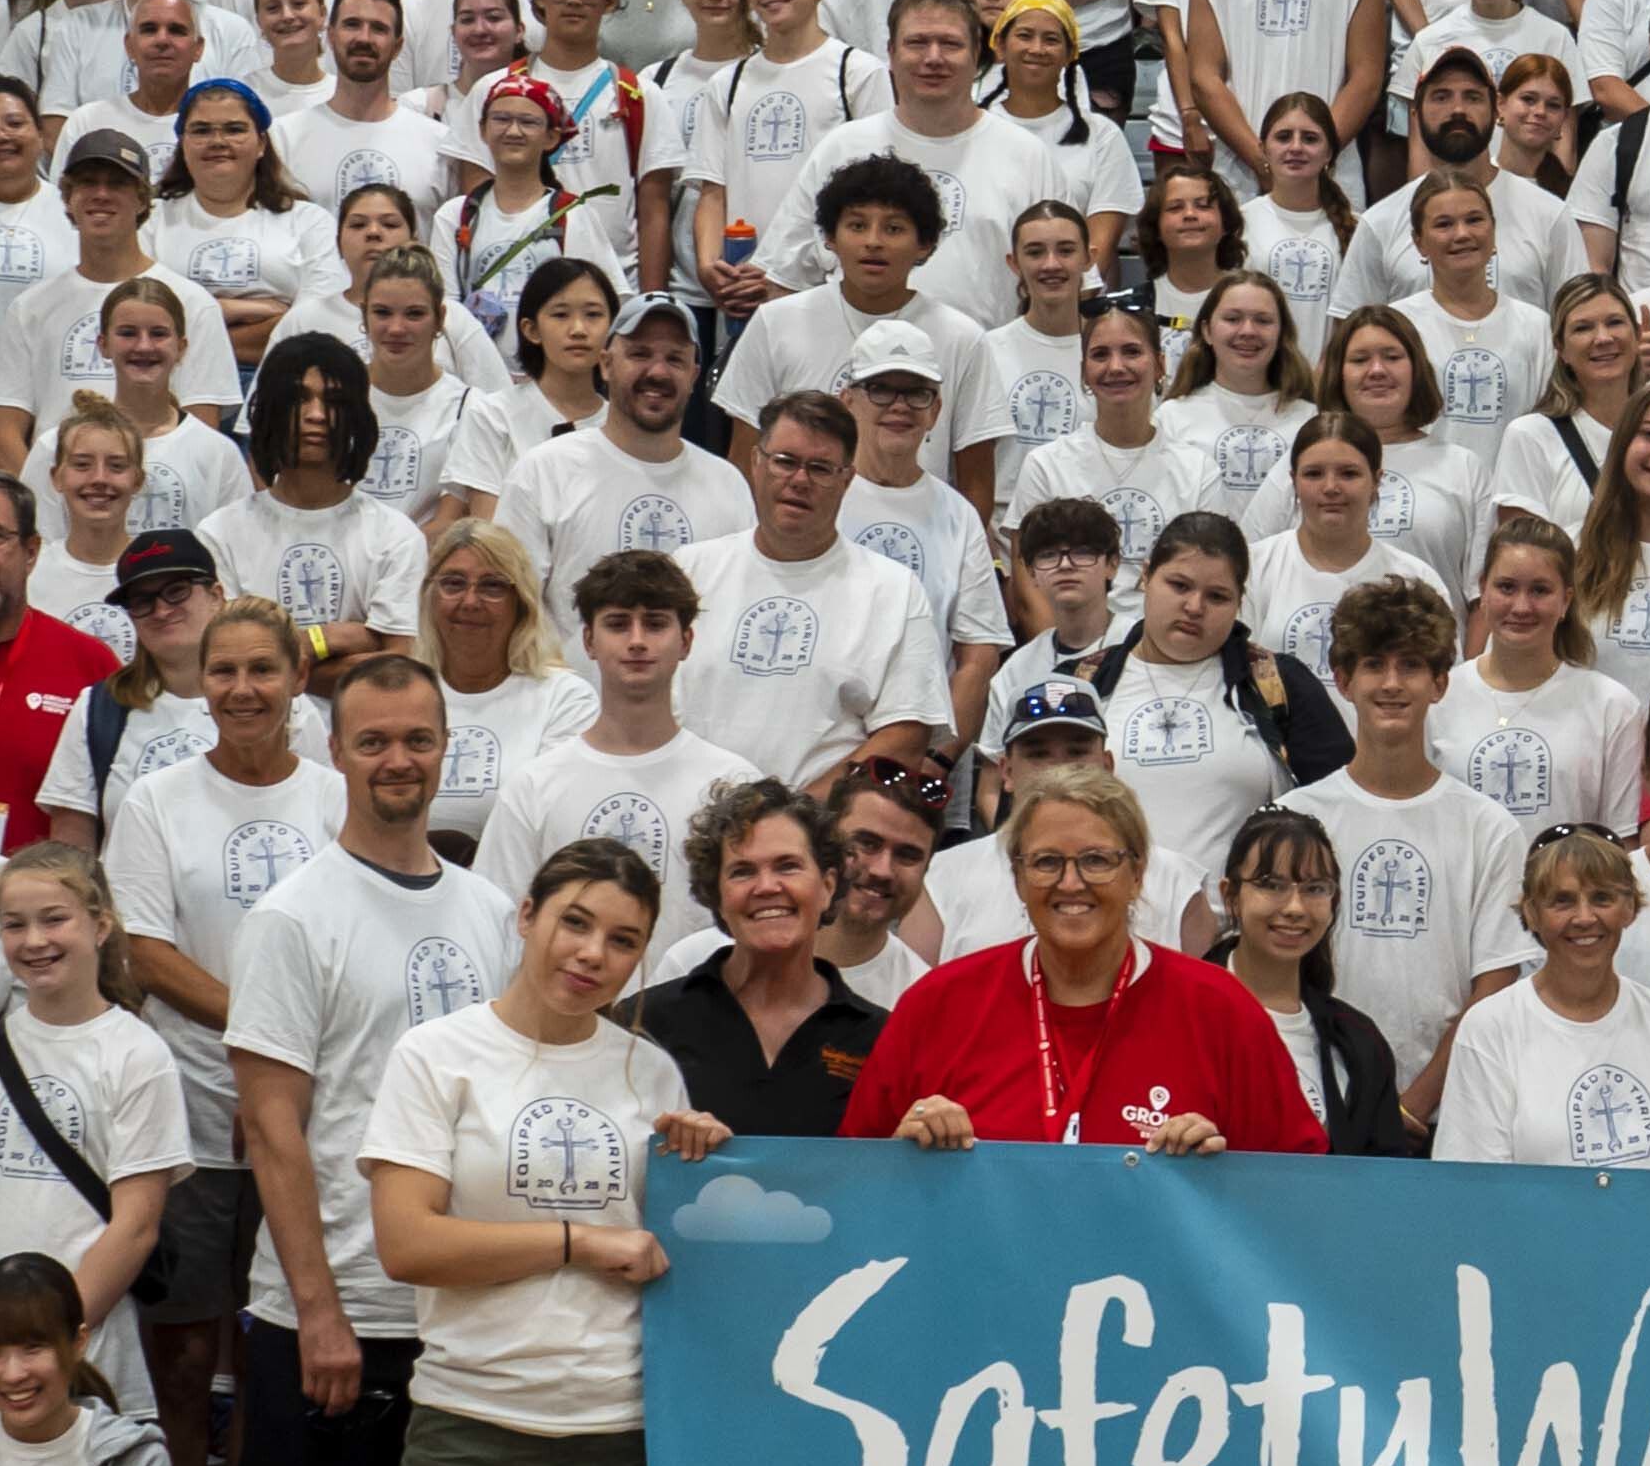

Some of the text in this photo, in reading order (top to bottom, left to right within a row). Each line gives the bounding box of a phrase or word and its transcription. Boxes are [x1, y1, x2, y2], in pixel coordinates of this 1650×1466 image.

[781, 96, 792, 104] TO
[1051, 376, 1063, 387] TO
[657, 501, 673, 512] TO
[311, 548, 338, 614] TO THRIVE
[737, 601, 812, 660] EQUIPPED TO THRIVE
[1130, 700, 1208, 753] EQUIPPED TO THRIVE
[1474, 733, 1546, 800] QUIPPED TO THRIVE
[230, 825, 287, 892] EQUIPPED TO
[630, 799, 662, 866] TO THRIV
[1356, 845, 1425, 925] EQUIPPED TO THRIVE
[437, 944, 456, 957] TO
[1573, 1074, 1597, 1153] EQUIPPED
[1605, 1070, 1623, 1083] TO
[515, 1104, 620, 1192] EQUIPPED TO THRIVE
[537, 1179, 554, 1188] 20
